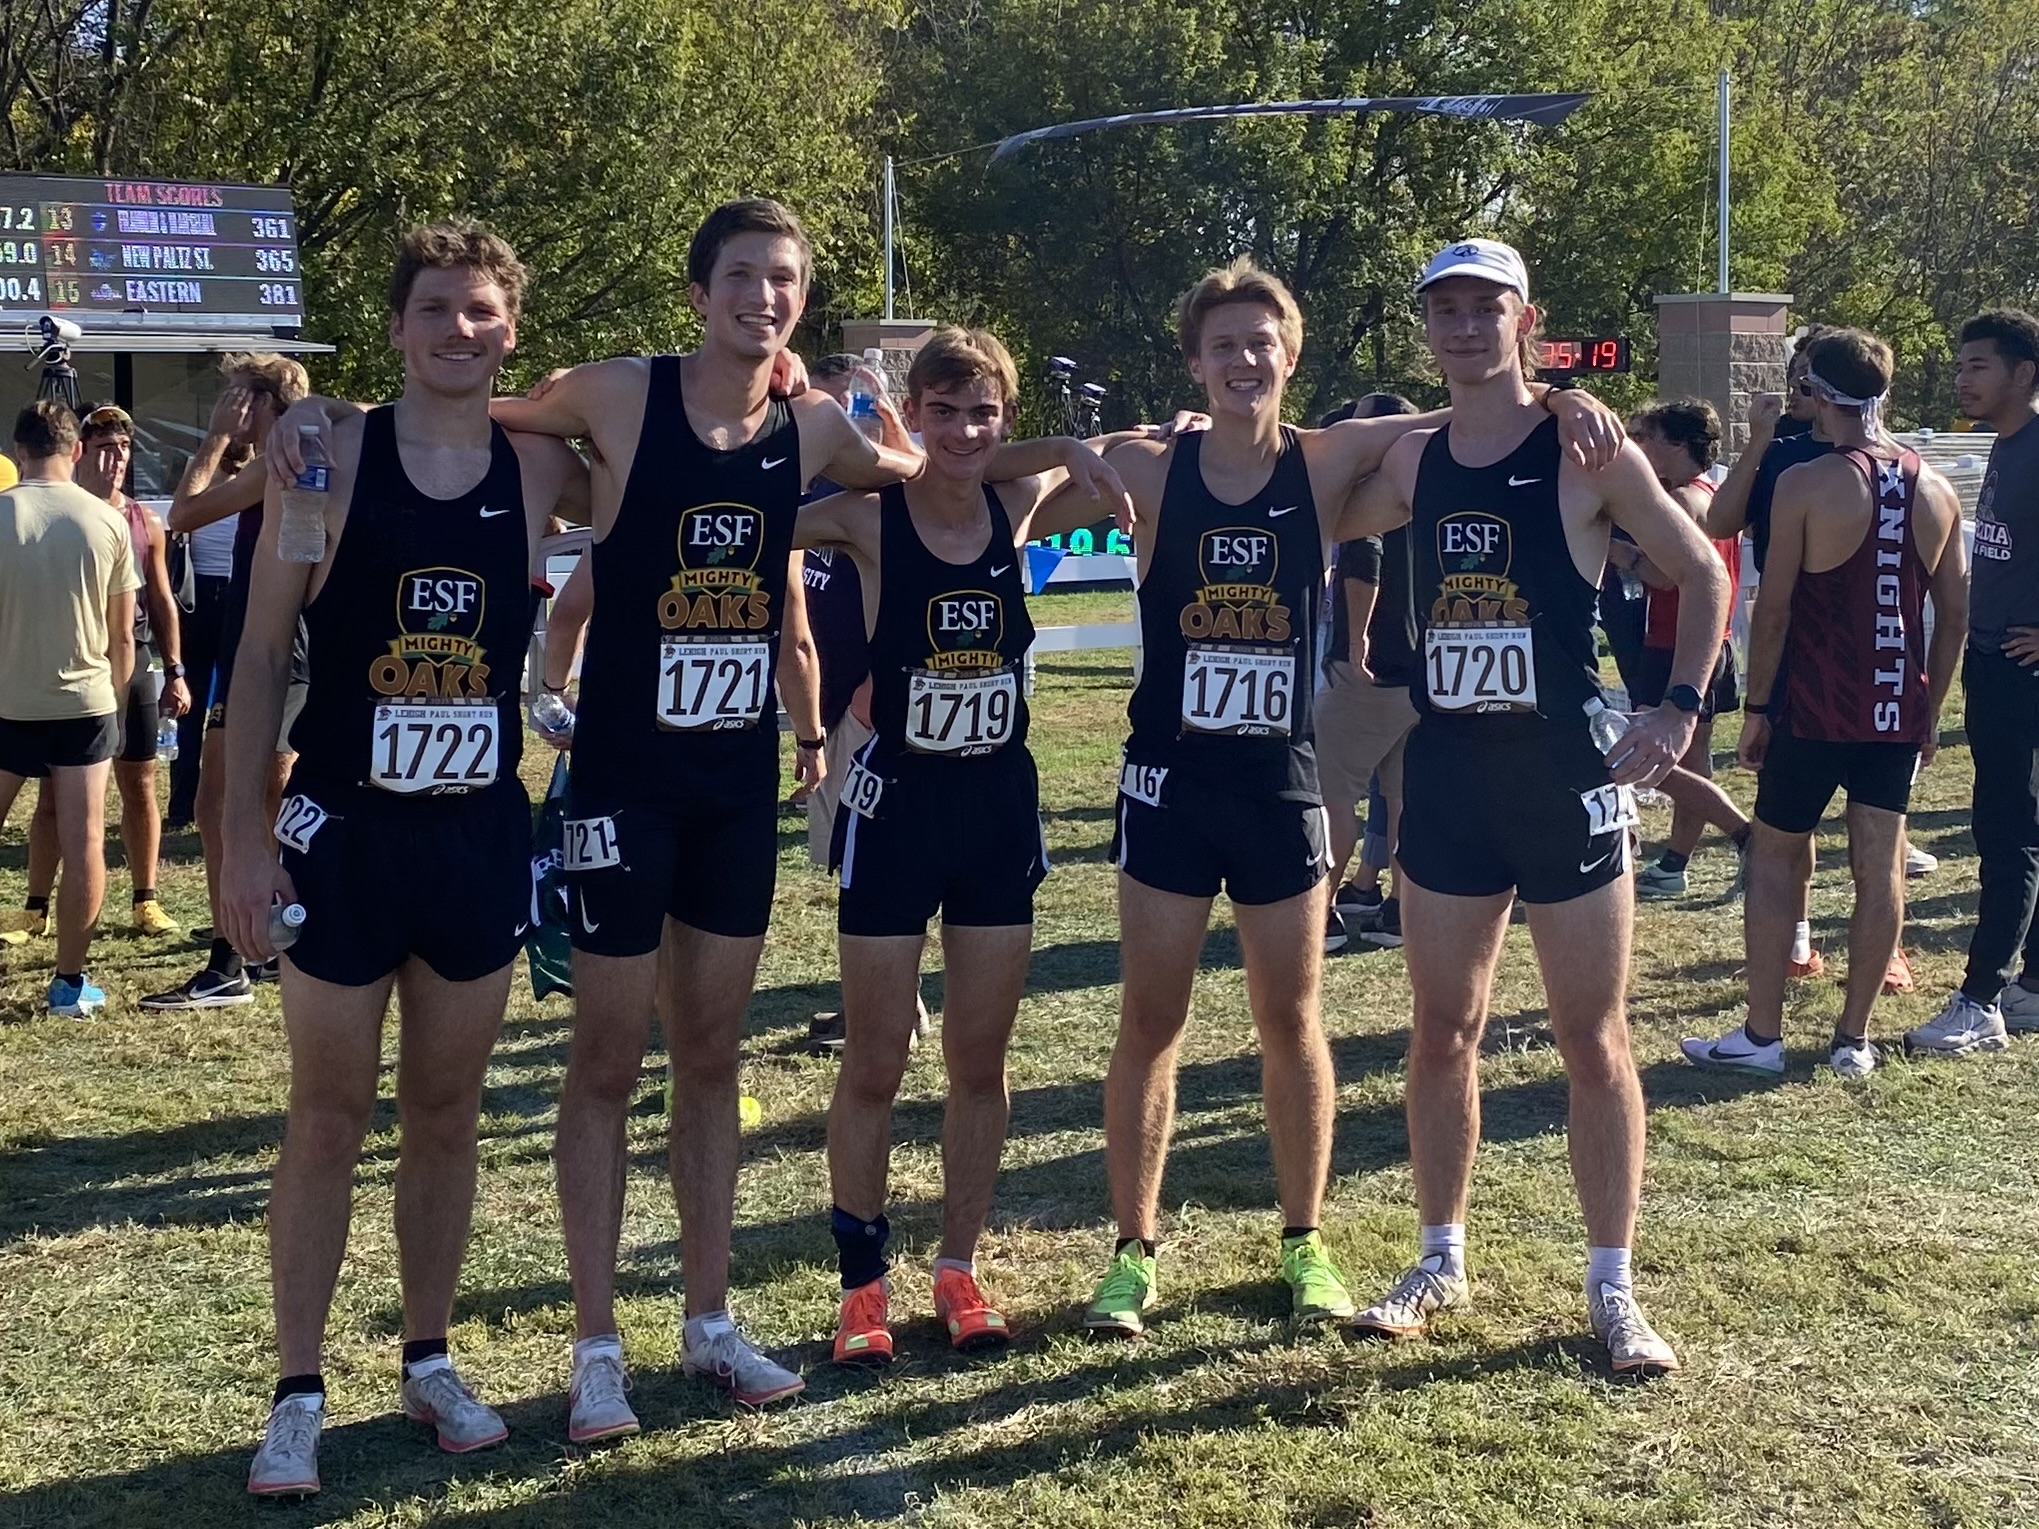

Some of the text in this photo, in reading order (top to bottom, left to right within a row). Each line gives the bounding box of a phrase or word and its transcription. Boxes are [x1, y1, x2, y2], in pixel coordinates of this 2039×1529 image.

[104, 183, 223, 207] TEAM SCORES
[48, 207, 73, 230] 13
[251, 217, 291, 239] 361
[0, 241, 37, 264] 9.0
[51, 243, 76, 266] 14
[121, 244, 150, 268] NEW
[153, 246, 192, 269] PALTZ
[255, 249, 294, 272] 365
[55, 280, 79, 303] 15
[125, 280, 201, 303] EASTERN
[259, 283, 298, 305] 381
[689, 515, 754, 546] ESF
[1442, 523, 1500, 553] ESF
[1209, 536, 1267, 565] ESF
[684, 570, 752, 586] MIGHTY
[801, 565, 831, 591] SITY
[408, 577, 477, 613] ESF
[1207, 585, 1271, 599] MIGHTY
[1873, 460, 1906, 732] KNIGHTS
[657, 590, 771, 629] OAKS
[939, 600, 995, 630] ESF
[1179, 602, 1291, 641] OAKS
[1432, 597, 1530, 624] OAKS
[404, 637, 475, 656] MIGHTY
[1464, 632, 1484, 640] PAUL
[710, 648, 729, 656] PAUL
[937, 652, 997, 667] MIGHTY
[1233, 657, 1253, 666] PAUL
[368, 654, 492, 698] OAKS
[1429, 644, 1528, 697] 1720
[665, 658, 761, 716] 1721
[959, 682, 978, 690] PAUL
[1190, 666, 1288, 722] 1716
[429, 710, 451, 719] PAUL
[914, 689, 1010, 742] 1719
[379, 723, 493, 780] 1722
[1590, 786, 1633, 827] 17
[565, 820, 611, 864] 721
